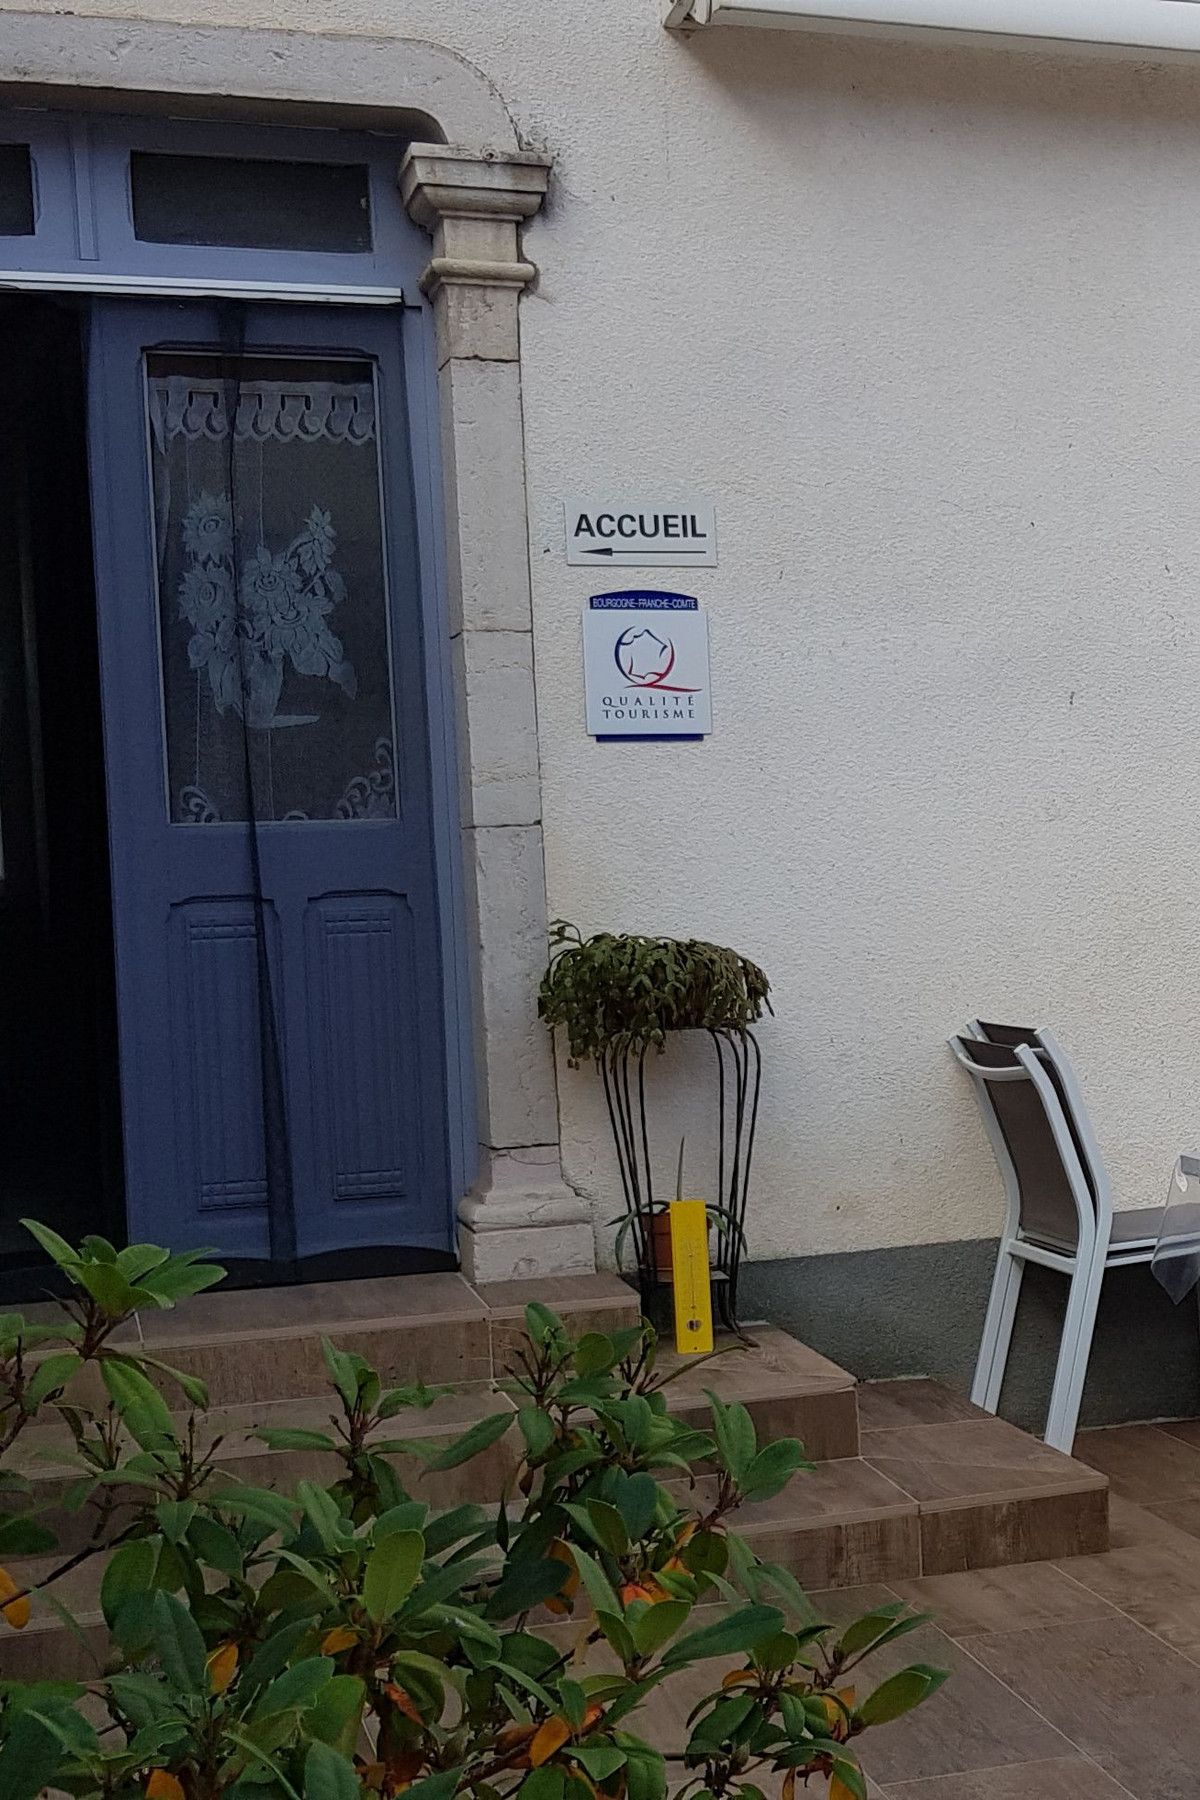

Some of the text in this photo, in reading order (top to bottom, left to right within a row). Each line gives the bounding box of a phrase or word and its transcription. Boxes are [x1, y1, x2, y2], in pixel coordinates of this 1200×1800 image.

[574, 514, 707, 538] ACCUEIL
[602, 695, 695, 708] QUALITÉ
[602, 709, 695, 719] TOURISME
